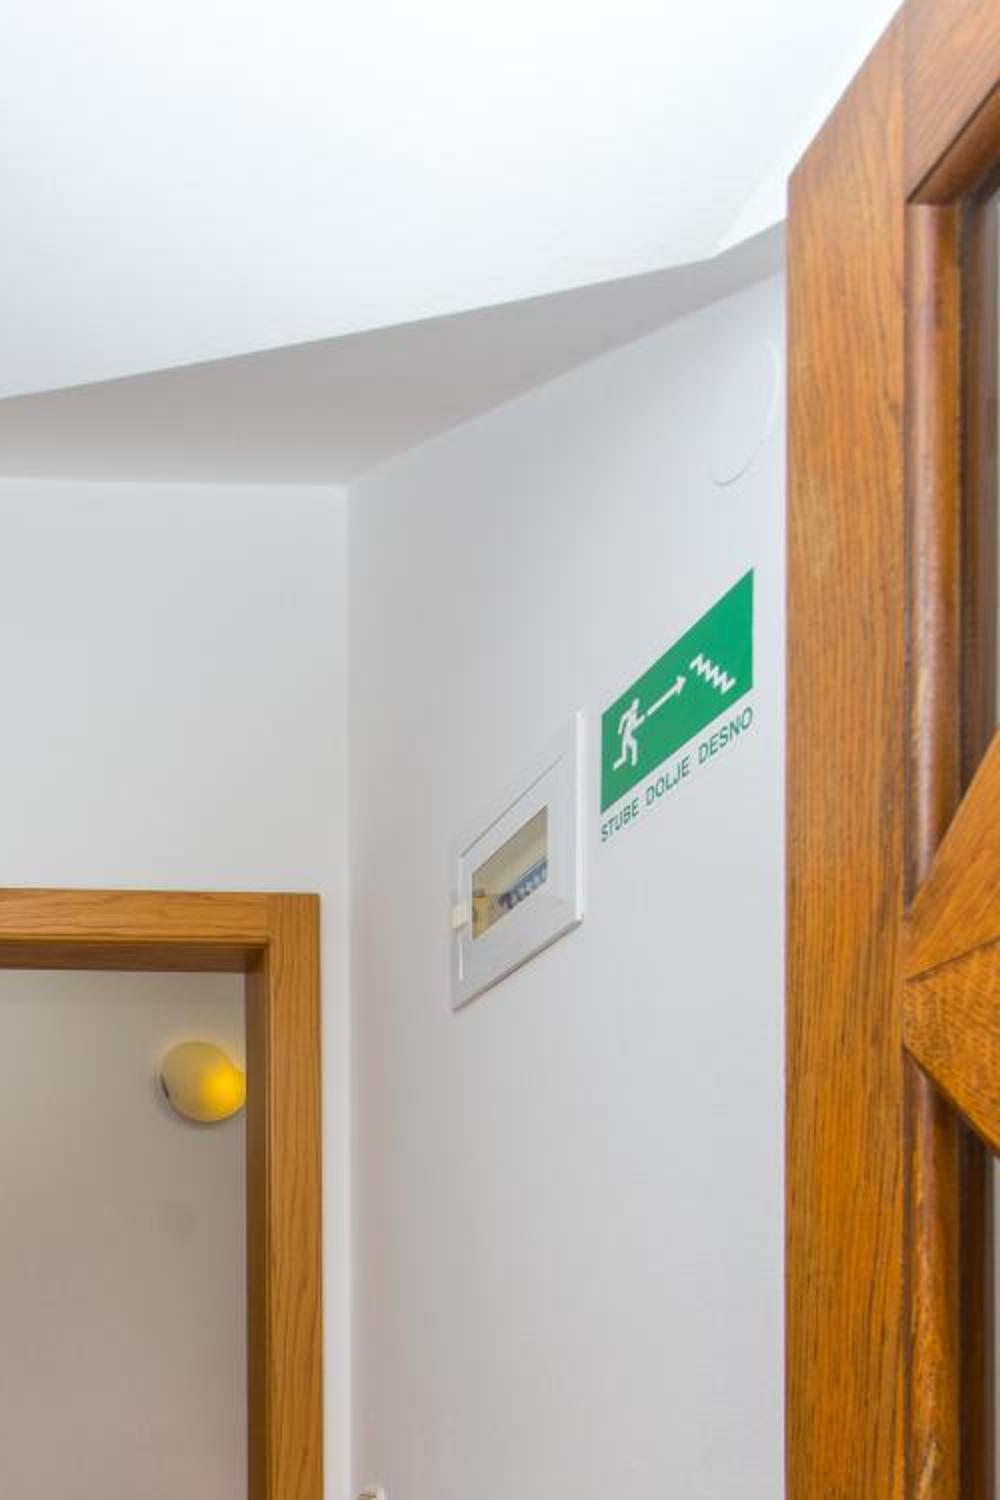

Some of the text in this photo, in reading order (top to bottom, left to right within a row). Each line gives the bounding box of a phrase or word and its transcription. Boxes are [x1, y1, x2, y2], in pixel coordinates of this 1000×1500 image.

[601, 706, 754, 842] STUBE DOLJE DESNO
